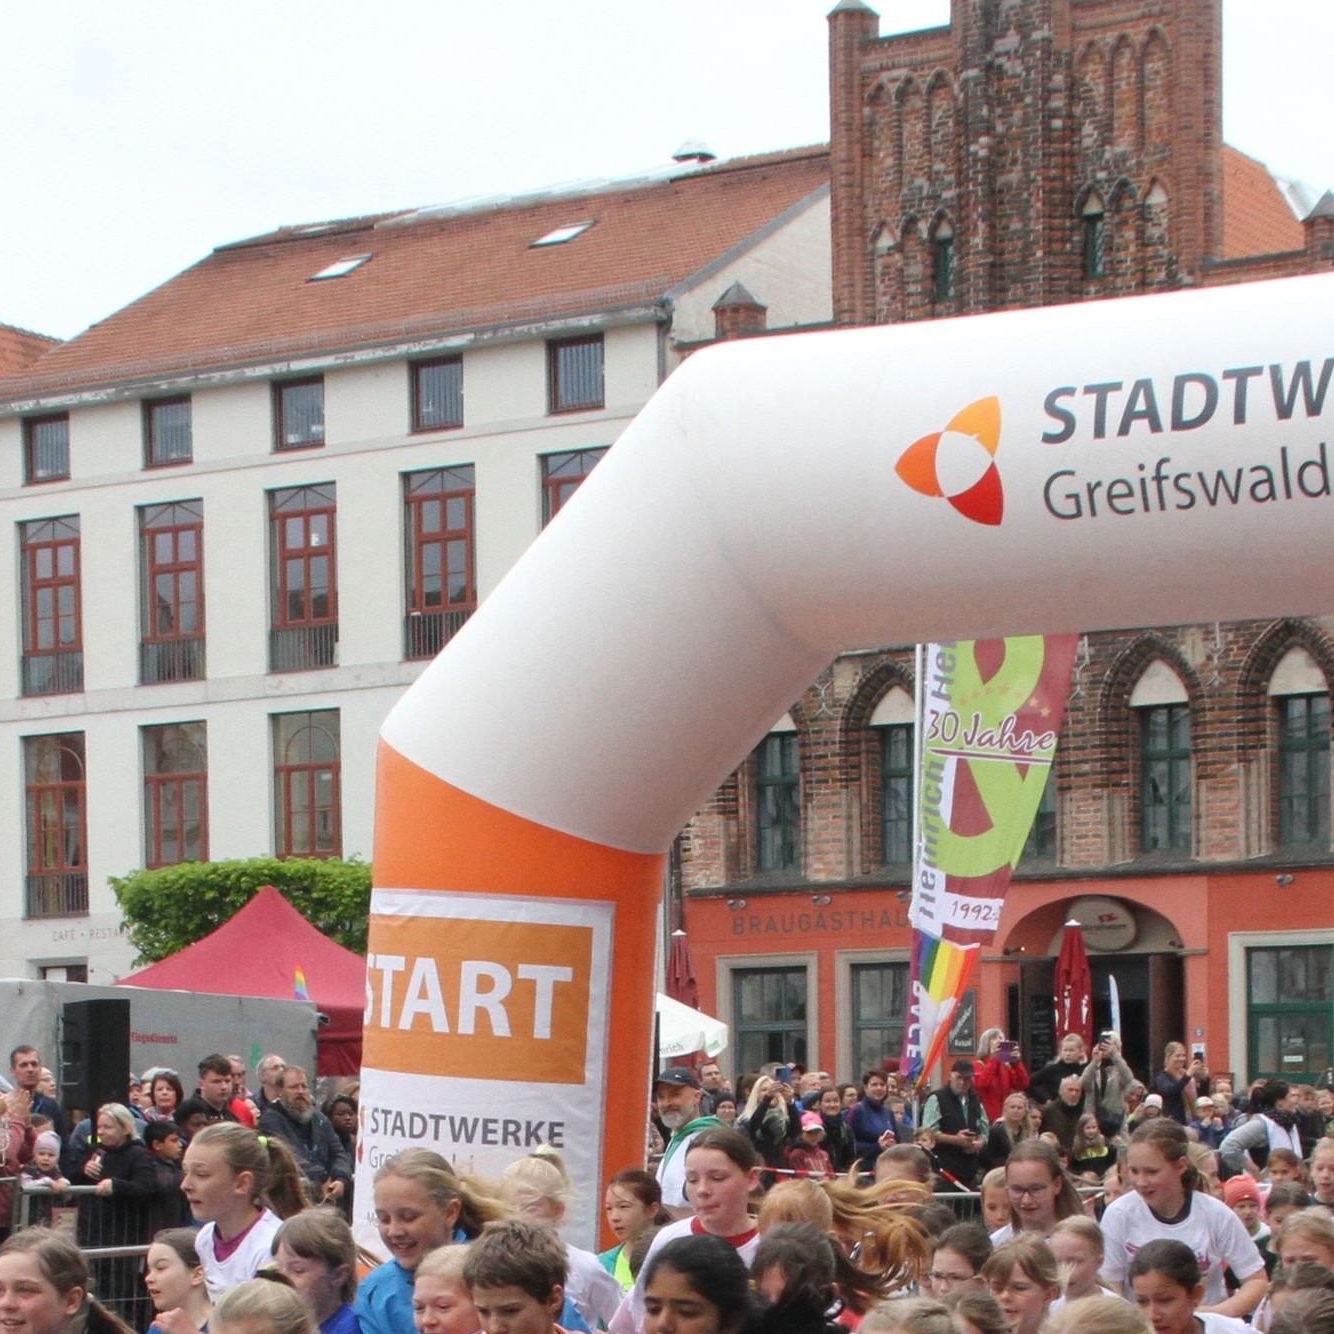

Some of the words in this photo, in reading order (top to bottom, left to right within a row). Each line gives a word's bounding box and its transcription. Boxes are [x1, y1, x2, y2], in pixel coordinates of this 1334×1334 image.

[1042, 442, 1332, 521] Greifswald
[928, 708, 961, 743] 30
[963, 712, 1056, 752] Jahre
[370, 1107, 565, 1149] STADTWERKE
